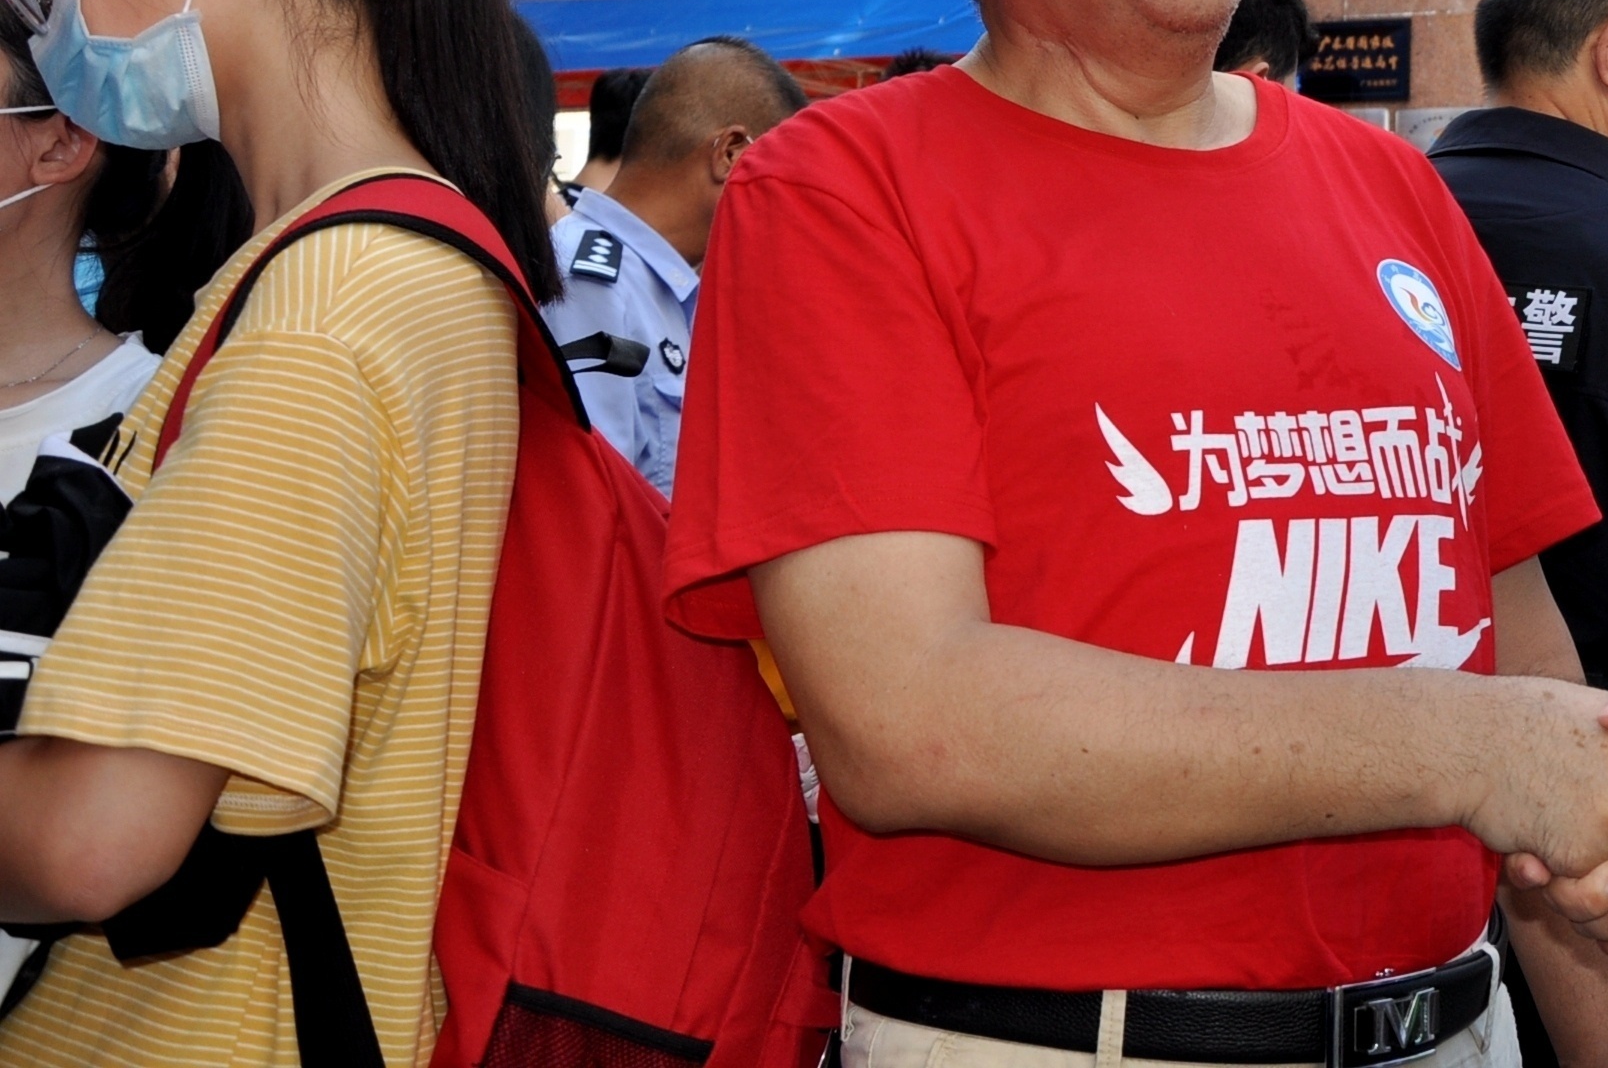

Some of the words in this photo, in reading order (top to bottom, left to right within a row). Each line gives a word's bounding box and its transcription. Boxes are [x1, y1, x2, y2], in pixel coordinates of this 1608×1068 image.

[1507, 289, 1578, 364] 警
[1170, 372, 1469, 532] 为梦想而战
[1212, 514, 1460, 670] NIKE
